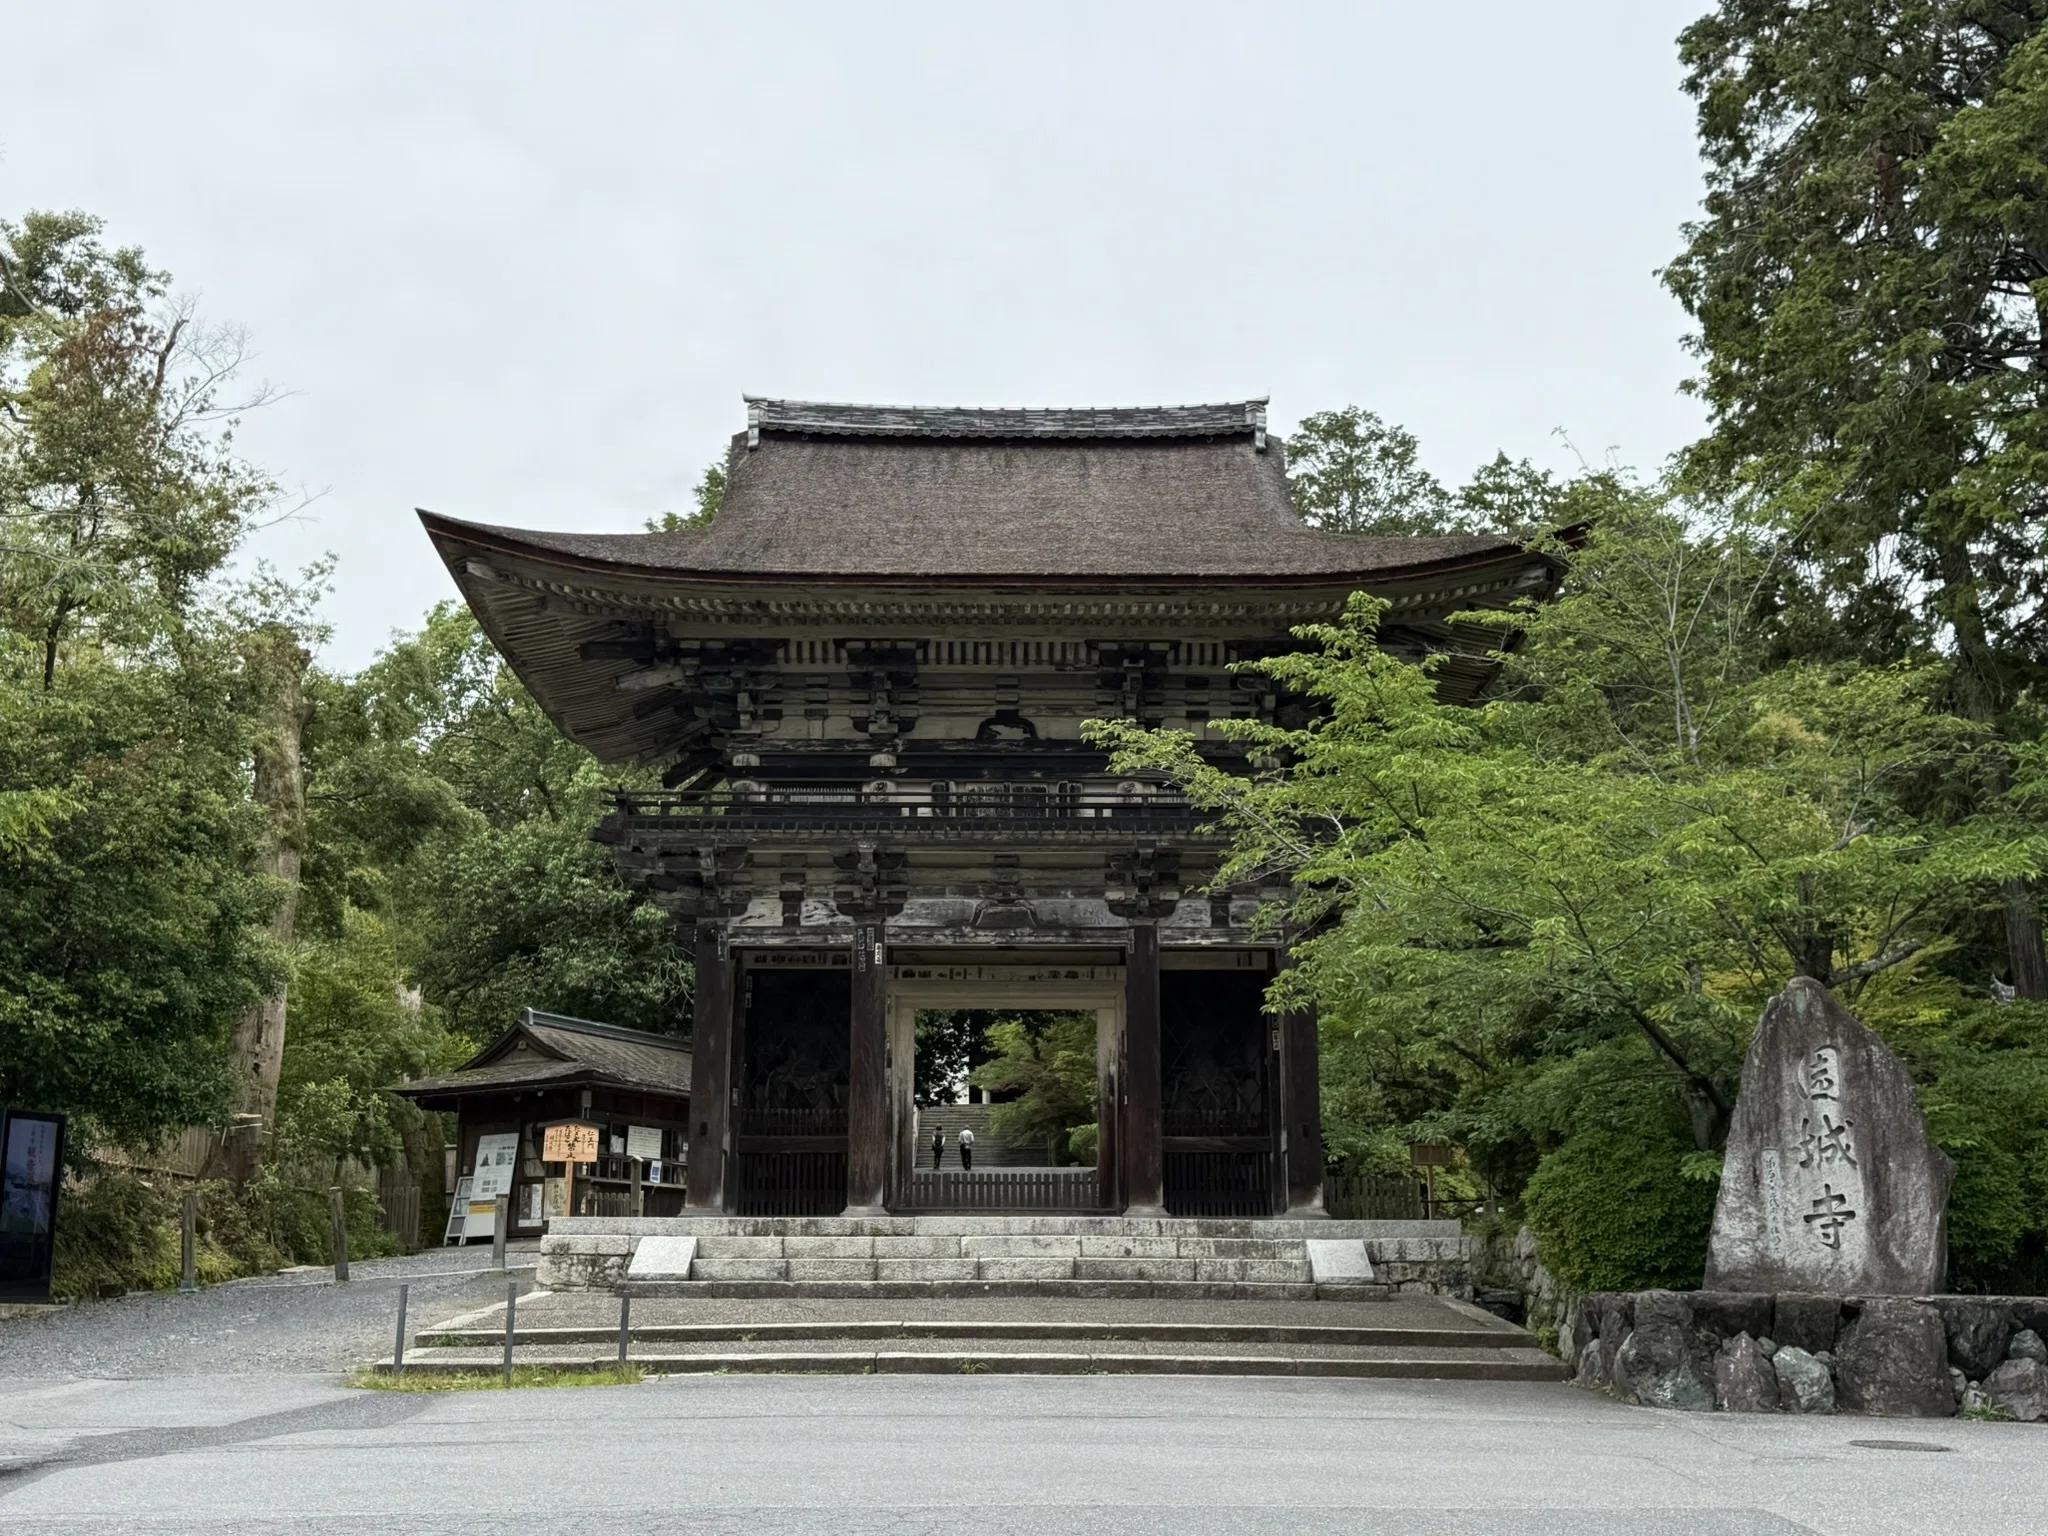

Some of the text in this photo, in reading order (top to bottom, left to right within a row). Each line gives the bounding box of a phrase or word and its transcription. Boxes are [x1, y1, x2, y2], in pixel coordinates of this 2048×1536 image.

[564, 1125, 572, 1143] たばこ
[587, 1130, 595, 1149] 仁王門
[565, 1142, 576, 1159] 禁止
[1797, 1045, 1857, 1249] 園城寺
